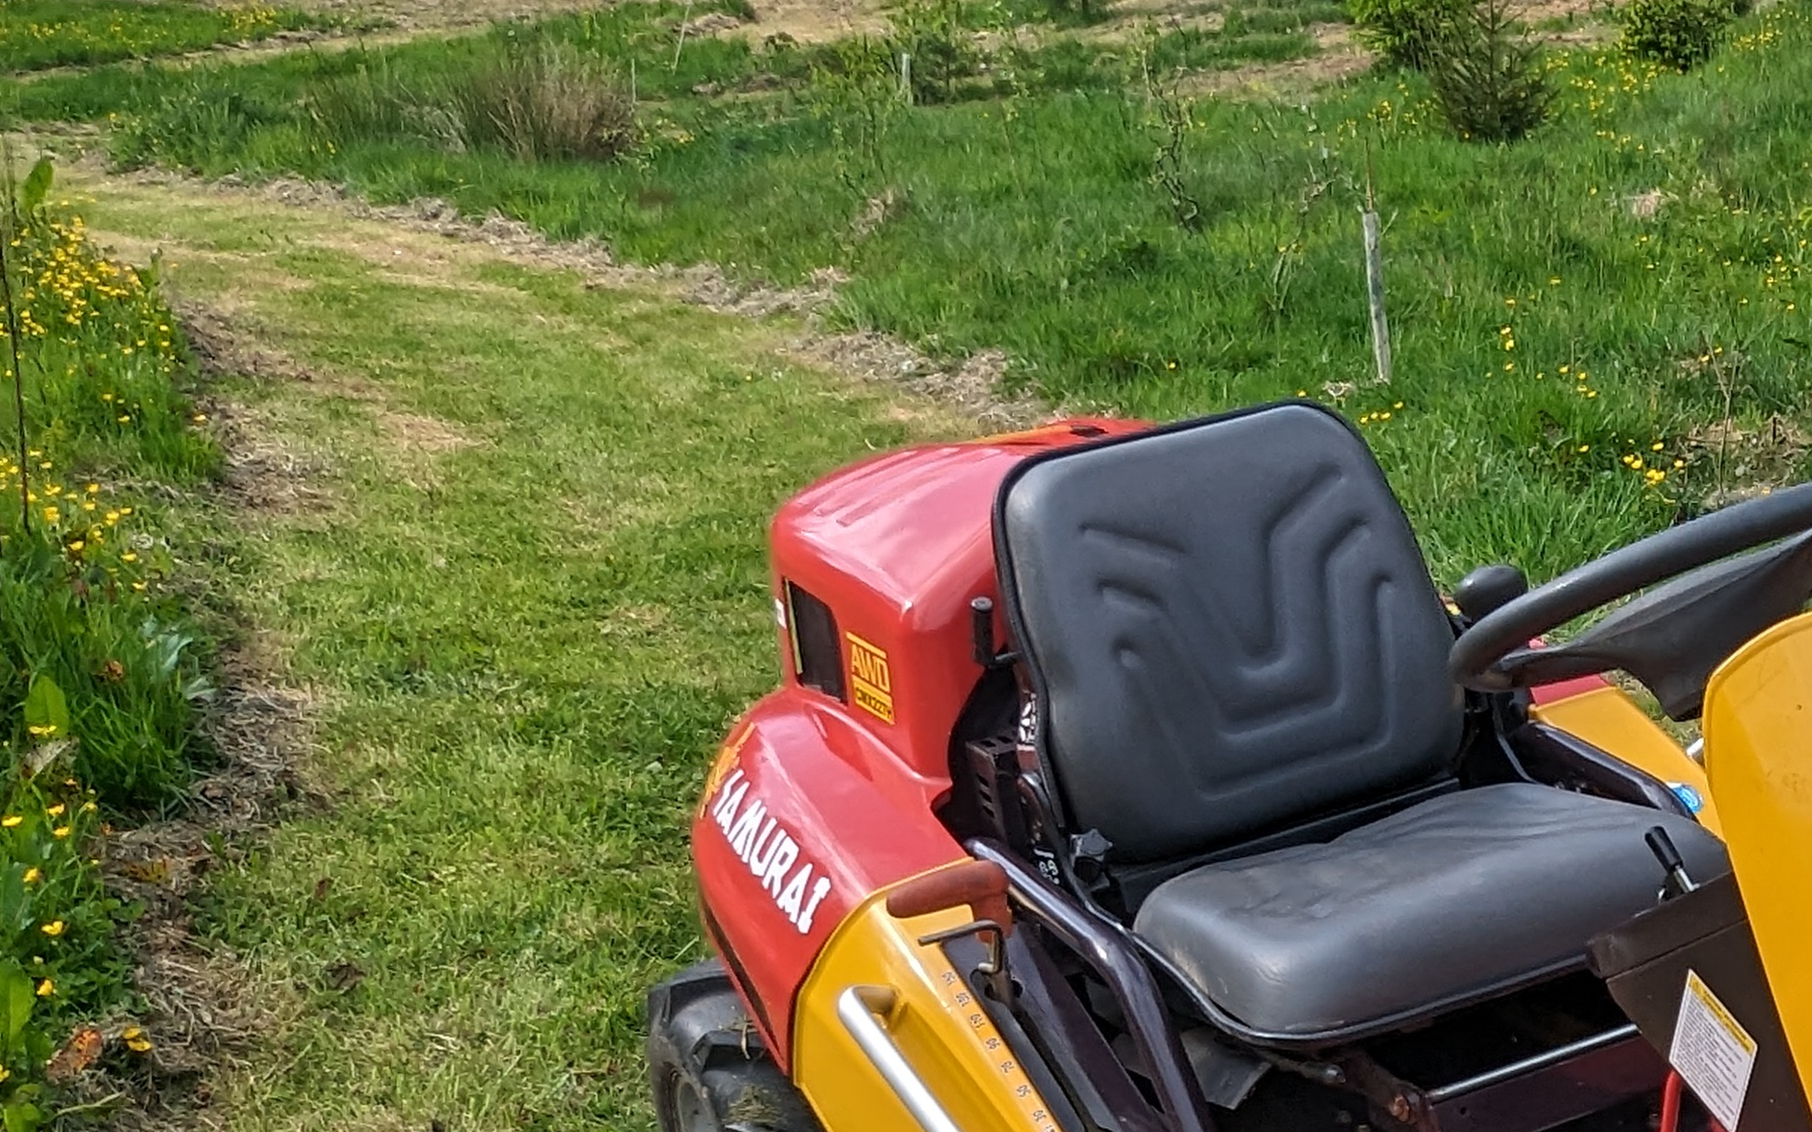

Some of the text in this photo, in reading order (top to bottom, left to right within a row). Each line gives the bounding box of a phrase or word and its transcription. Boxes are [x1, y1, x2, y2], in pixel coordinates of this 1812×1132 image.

[851, 643, 891, 693] AWD
[712, 768, 832, 935] SAMURAI
[985, 1037, 1001, 1050] 90
[1016, 1084, 1031, 1097] 50
